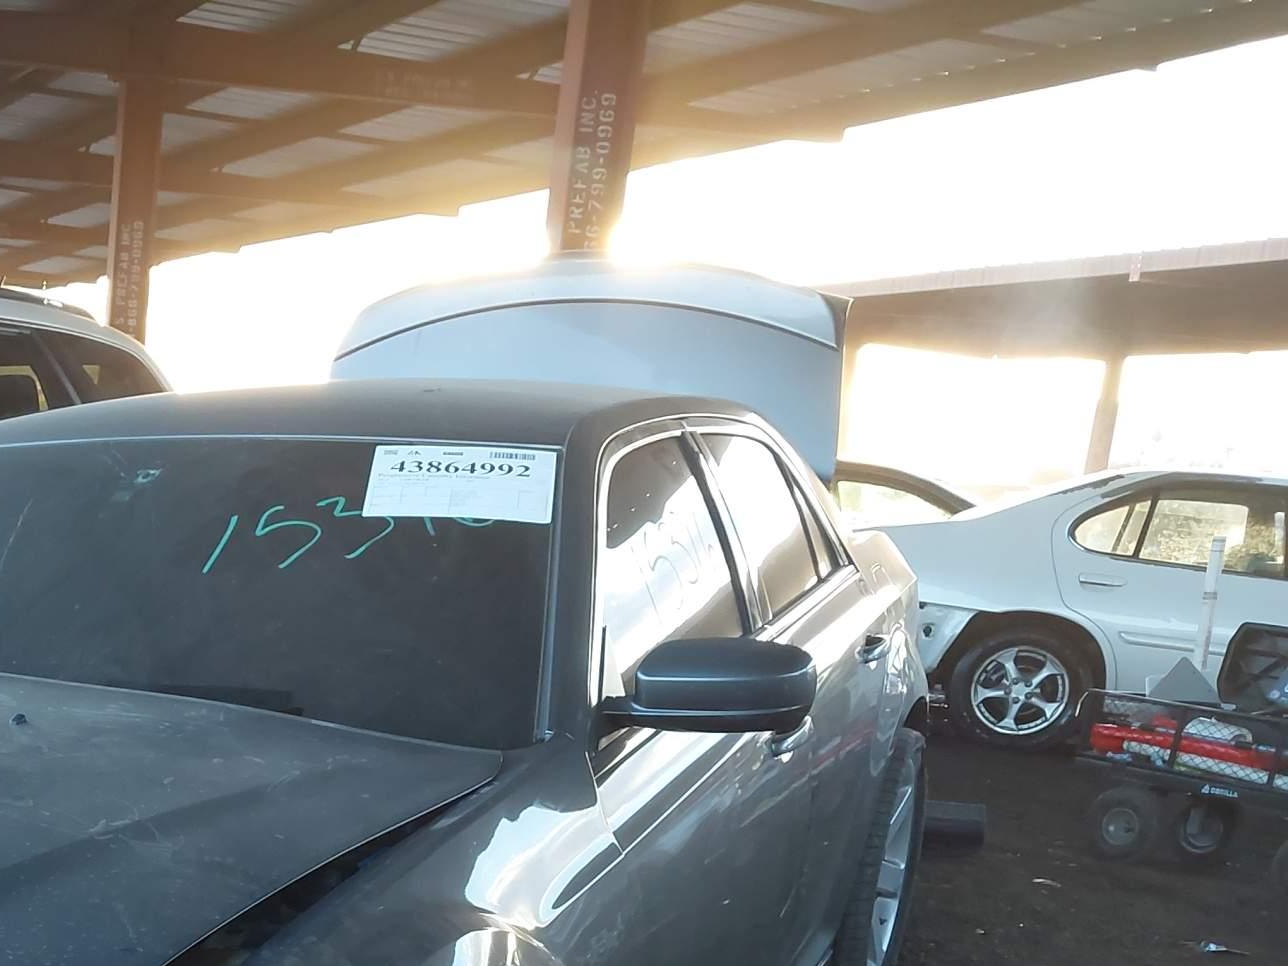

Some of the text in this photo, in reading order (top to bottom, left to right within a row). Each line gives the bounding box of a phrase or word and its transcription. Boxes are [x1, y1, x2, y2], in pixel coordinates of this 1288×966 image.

[568, 90, 598, 234] PREFAB INC.
[390, 460, 533, 478] 43864992
